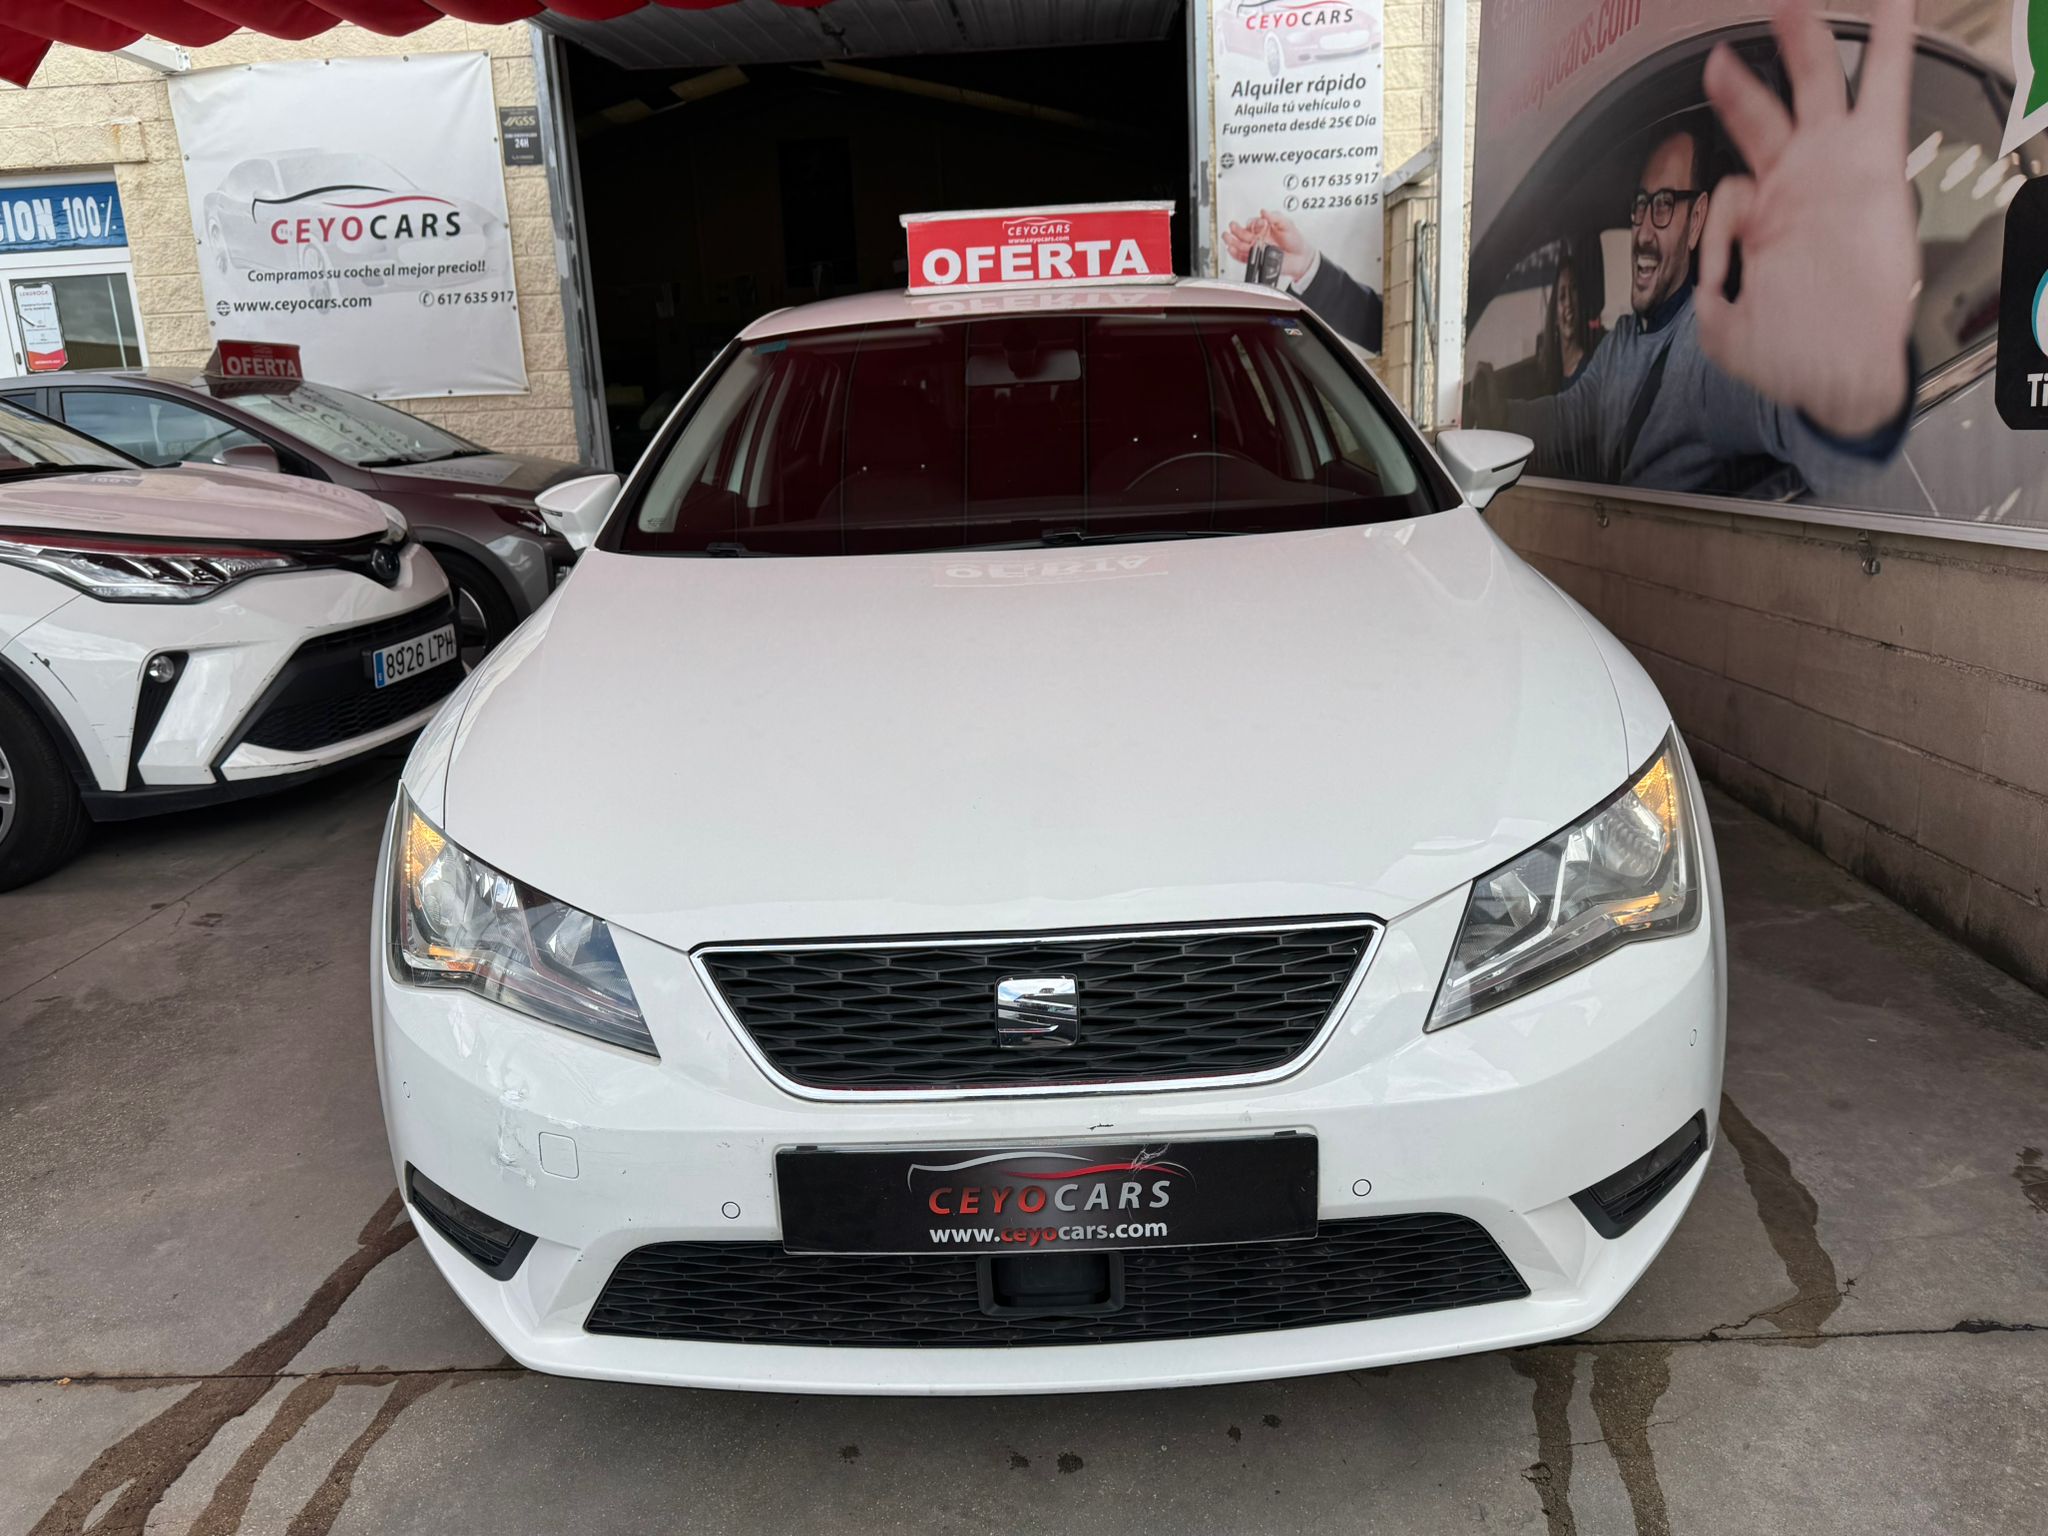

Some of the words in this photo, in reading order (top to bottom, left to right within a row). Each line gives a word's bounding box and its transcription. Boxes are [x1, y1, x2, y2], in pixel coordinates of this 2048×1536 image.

[1246, 8, 1353, 30] CEYOCARS
[1231, 77, 1303, 100] Alquiler
[1307, 73, 1366, 95] rápido
[1235, 102, 1279, 117] Alquila
[1282, 100, 1295, 113] tú
[1298, 97, 1350, 111] vehículo
[1353, 98, 1361, 109] o
[1222, 121, 1287, 137] Furgoneta
[1329, 116, 1353, 129] 25€
[1355, 114, 1377, 127] Día
[1238, 145, 1378, 164] www.ceyocars.com
[1302, 175, 1326, 188] 617
[1328, 174, 1352, 186] 635
[1354, 172, 1379, 185] 917
[1302, 196, 1326, 209] 622
[1328, 195, 1352, 208] 236
[1354, 193, 1379, 206] 615
[0, 198, 56, 242] ION
[62, 196, 117, 239] 100%
[271, 211, 461, 245] CEYOCARS
[1008, 224, 1071, 237] CEYOCARS
[1008, 235, 1070, 244] www.ceyocars.com
[247, 269, 324, 284] Compramos
[326, 268, 341, 279] su
[344, 265, 380, 278] coche
[383, 263, 395, 277] al
[398, 263, 435, 278] mejor
[437, 260, 485, 277] precio!!
[922, 239, 1150, 285] OFERTA
[233, 296, 372, 314] www.ceyocars.com
[437, 293, 461, 305] 617
[464, 292, 488, 304] 635
[491, 290, 514, 303] 917
[226, 355, 298, 377] OFERTA
[386, 643, 425, 679] 8926
[428, 630, 453, 663] LPH
[928, 1180, 1171, 1215] CEYOCARS
[929, 1221, 1168, 1247] www.ceyocars.com
